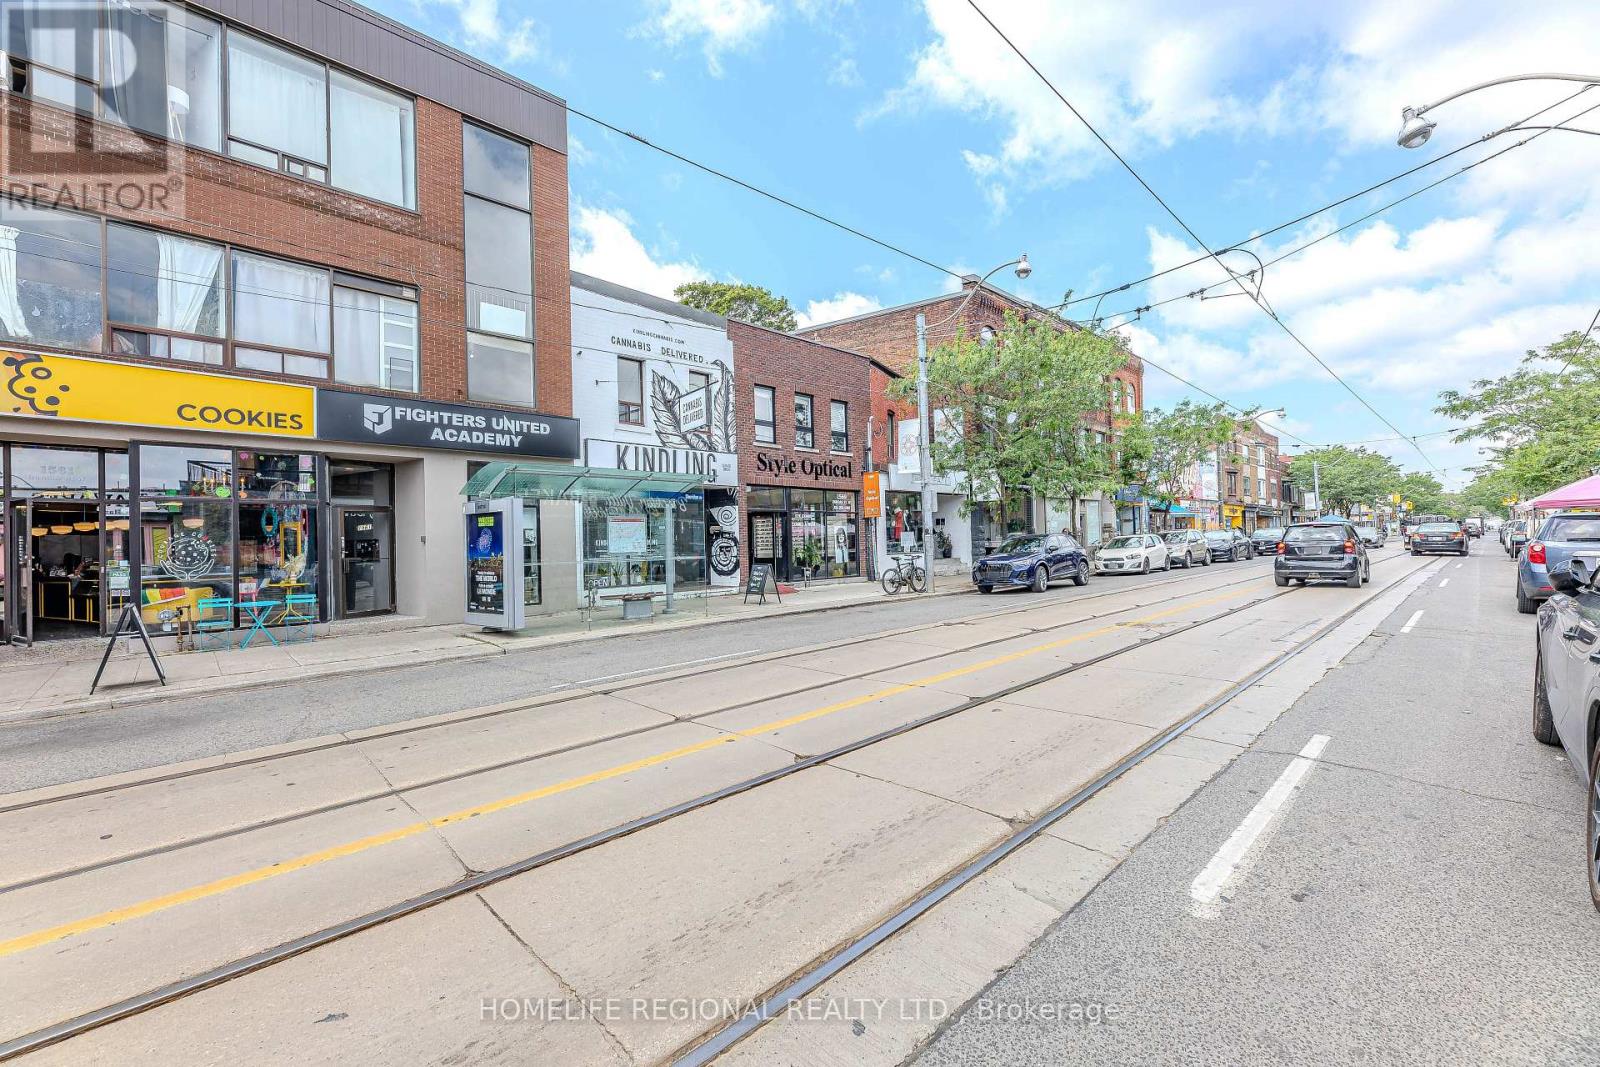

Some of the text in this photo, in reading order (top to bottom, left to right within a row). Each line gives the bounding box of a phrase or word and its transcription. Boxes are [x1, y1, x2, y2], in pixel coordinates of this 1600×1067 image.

[611, 335, 652, 353] CANNABIS
[682, 397, 703, 414] CANNABIS
[176, 403, 304, 430] COOKIES
[395, 407, 551, 436] FIGHTERS UNITED
[682, 408, 704, 425] DELIVERED
[430, 427, 523, 448] ACADEMY
[616, 444, 718, 484] KINDLING
[756, 453, 797, 477] Style
[801, 458, 853, 481] Optical
[587, 578, 608, 587] OPEN
